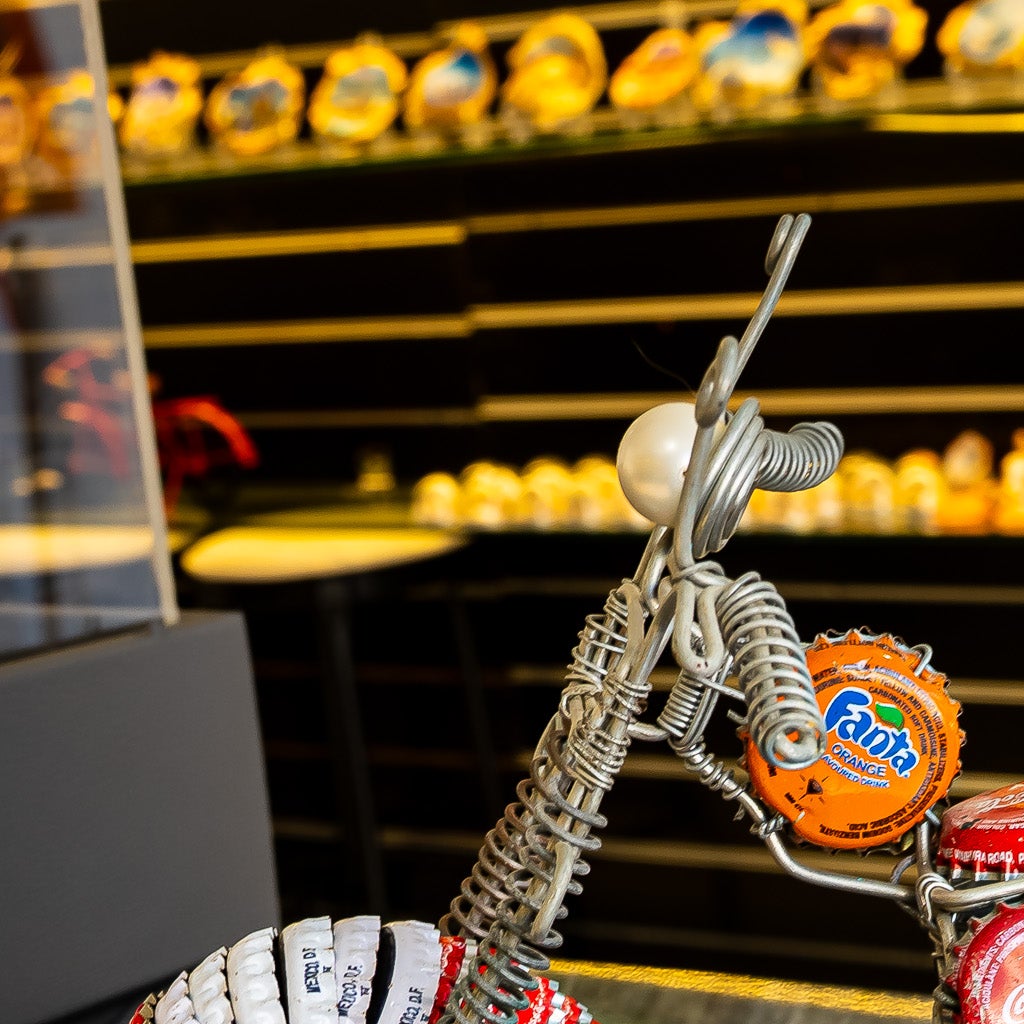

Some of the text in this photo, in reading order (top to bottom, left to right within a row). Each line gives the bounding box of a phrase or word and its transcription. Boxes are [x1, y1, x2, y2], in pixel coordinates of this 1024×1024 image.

[824, 687, 919, 777] Fanta
[822, 755, 860, 784] AVOURED
[831, 744, 887, 777] ORANGE
